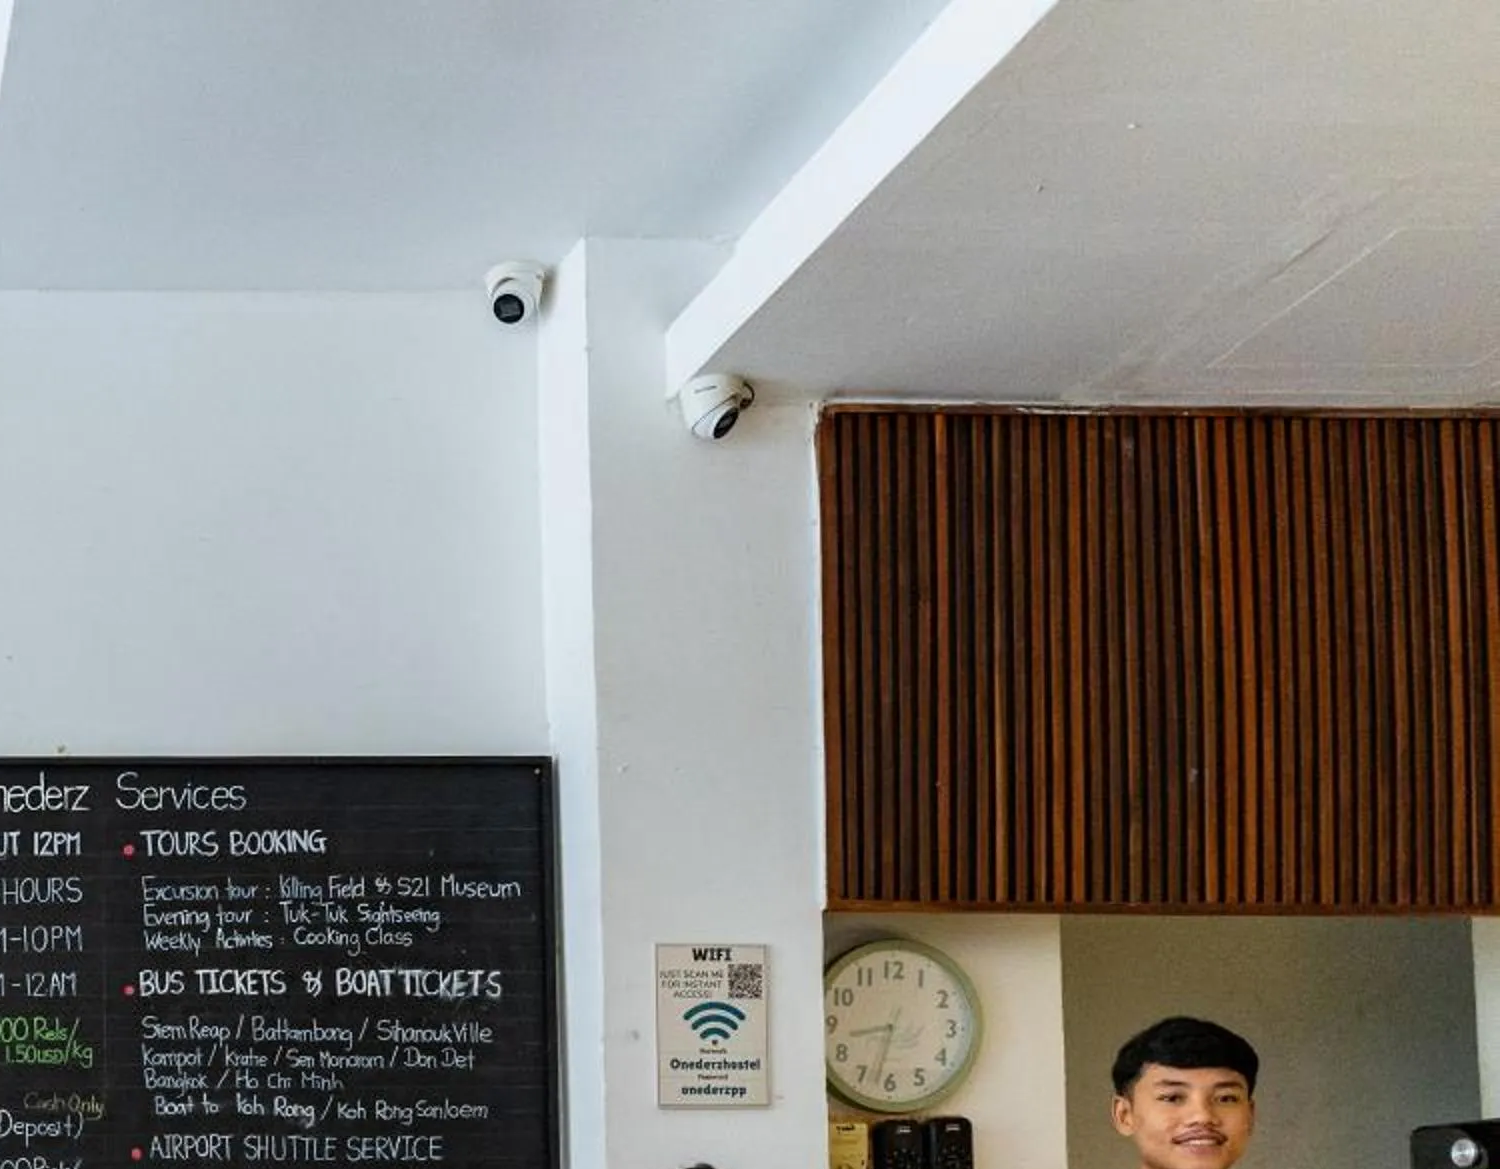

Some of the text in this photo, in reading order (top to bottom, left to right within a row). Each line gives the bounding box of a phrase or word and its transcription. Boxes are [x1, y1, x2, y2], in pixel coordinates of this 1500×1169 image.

[116, 771, 247, 811] Services
[33, 831, 82, 857] 12PM
[139, 829, 327, 857] TOURS BOOKING
[141, 874, 219, 902] Excursion
[397, 876, 430, 897] S21
[440, 873, 522, 898] Museum
[142, 903, 211, 934] Evening
[293, 926, 361, 957] Cooking
[365, 926, 414, 948] Class
[692, 947, 732, 961] WIFI
[857, 967, 872, 987] 11
[883, 960, 905, 980] 12
[917, 968, 925, 988] 1
[138, 969, 185, 997] BUS
[194, 969, 288, 996] TICKETS
[834, 987, 854, 1007] 10
[935, 990, 949, 1009] 2
[188, 1014, 231, 1048] Reap
[826, 1015, 838, 1034] 9
[946, 1019, 958, 1038] 3
[440, 1046, 476, 1071] Det
[835, 1043, 848, 1062] 8
[934, 1047, 947, 1067] 4
[235, 1067, 259, 1089] Ho
[856, 1065, 868, 1083] 7
[884, 1073, 897, 1092] 6
[913, 1068, 926, 1087] 5
[153, 1094, 195, 1116] Boat
[201, 1092, 220, 1115] to
[236, 1092, 265, 1116] Koh
[336, 1099, 367, 1120] Koh
[150, 1133, 445, 1162] AIRPORT SHUTTLE SERVICE
